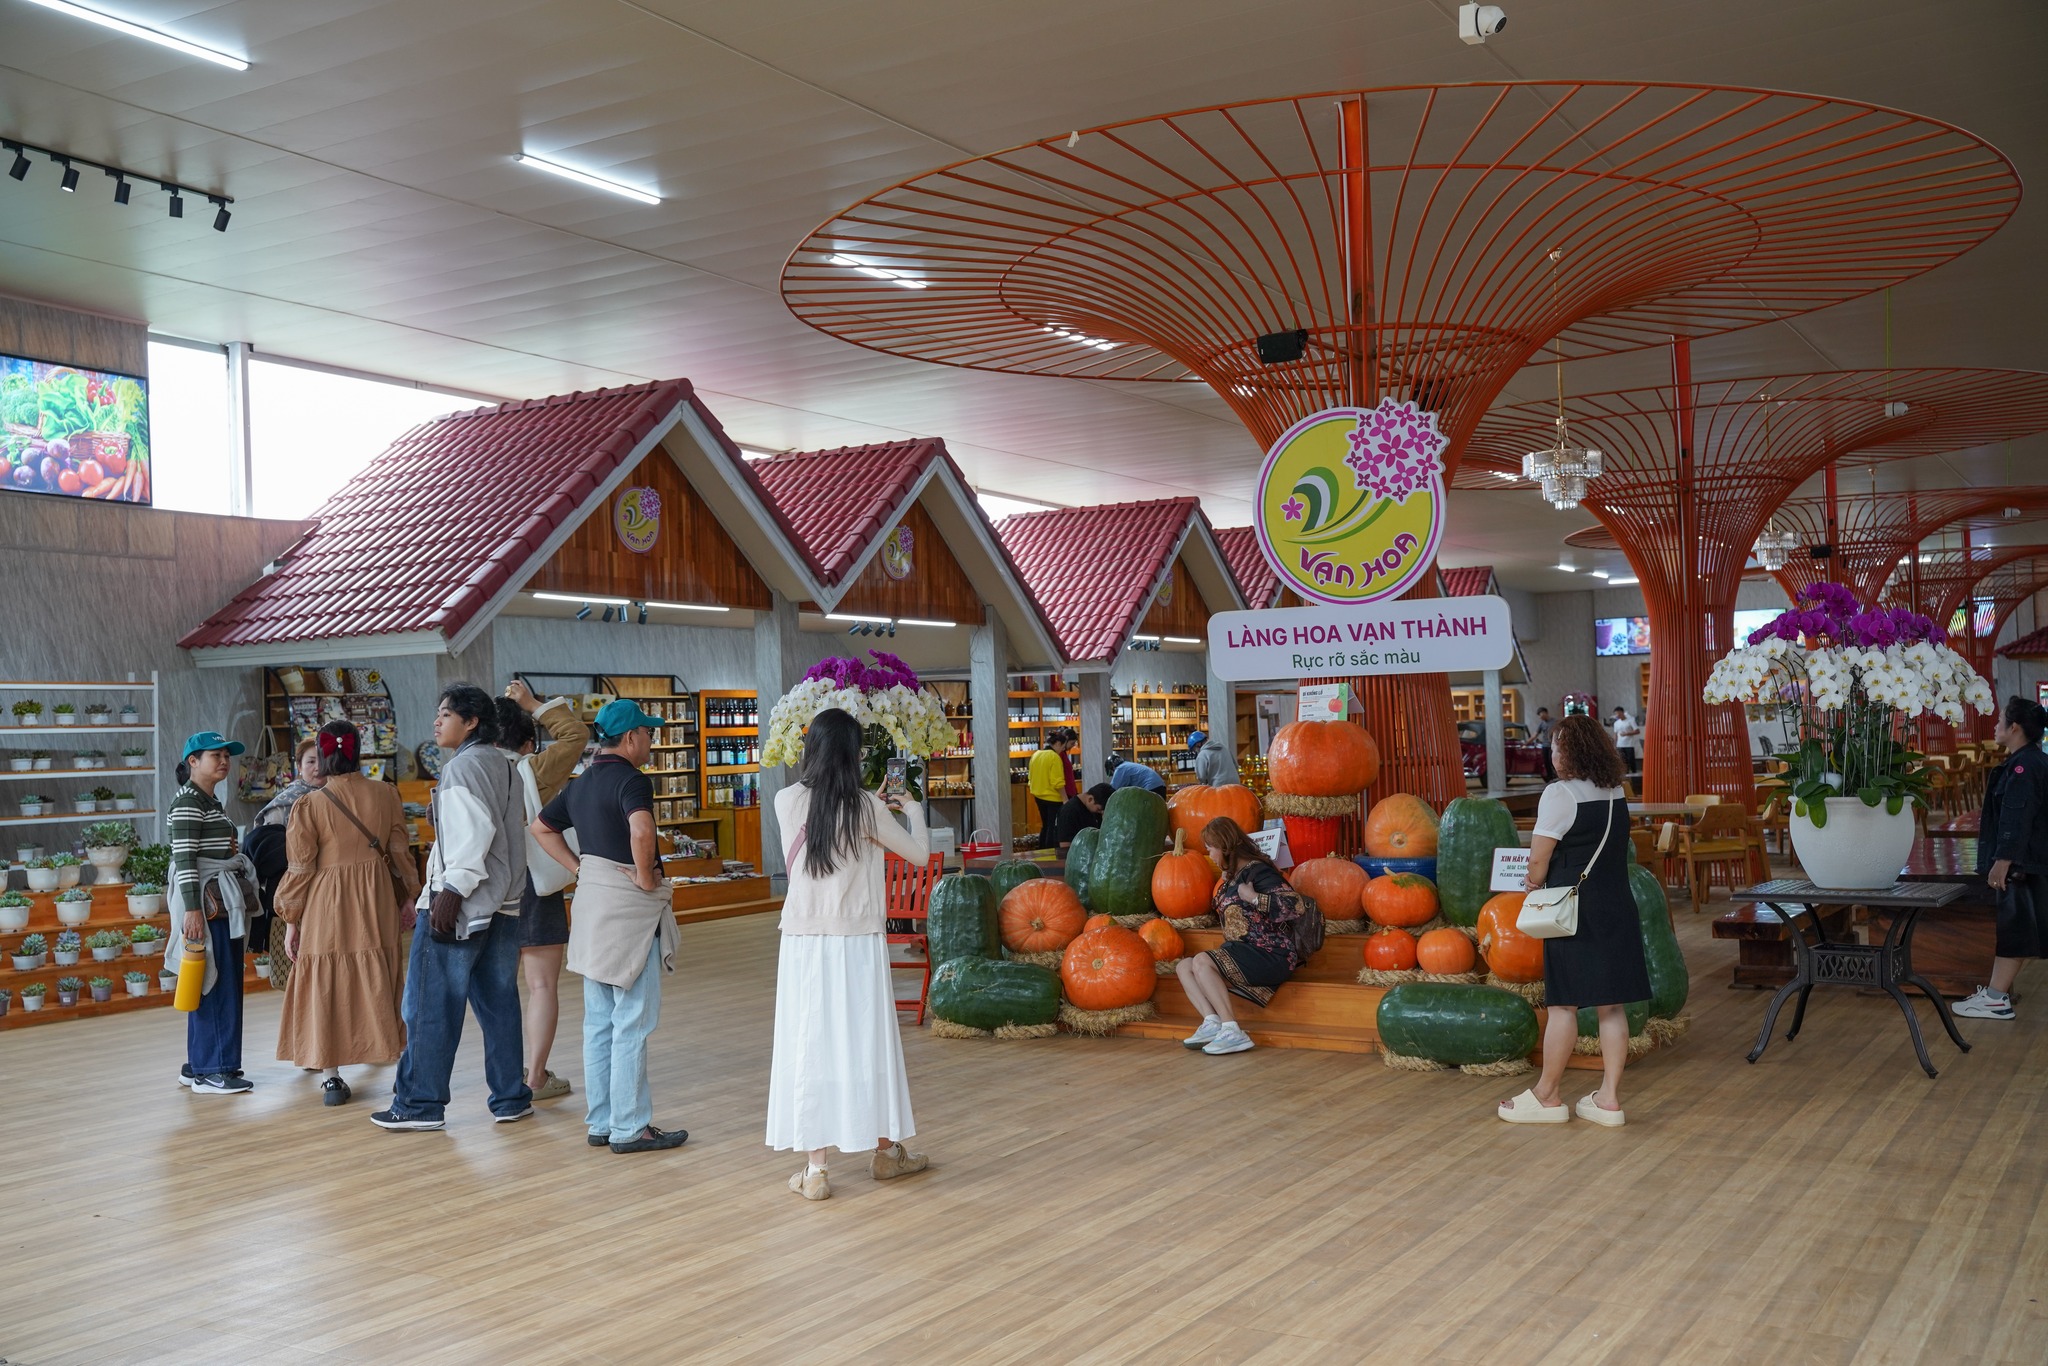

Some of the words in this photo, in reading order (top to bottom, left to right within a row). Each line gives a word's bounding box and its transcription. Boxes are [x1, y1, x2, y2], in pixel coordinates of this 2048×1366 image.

[1359, 532, 1418, 589] HOA
[1227, 623, 1288, 649] LÀNG
[1292, 625, 1343, 645] HOA
[1346, 621, 1396, 646] VẠN
[1400, 612, 1488, 639] THÀNH
[1292, 653, 1324, 669] Rực
[1328, 651, 1346, 667] rỡ
[1350, 649, 1380, 666] sắc
[1384, 648, 1421, 665] màu
